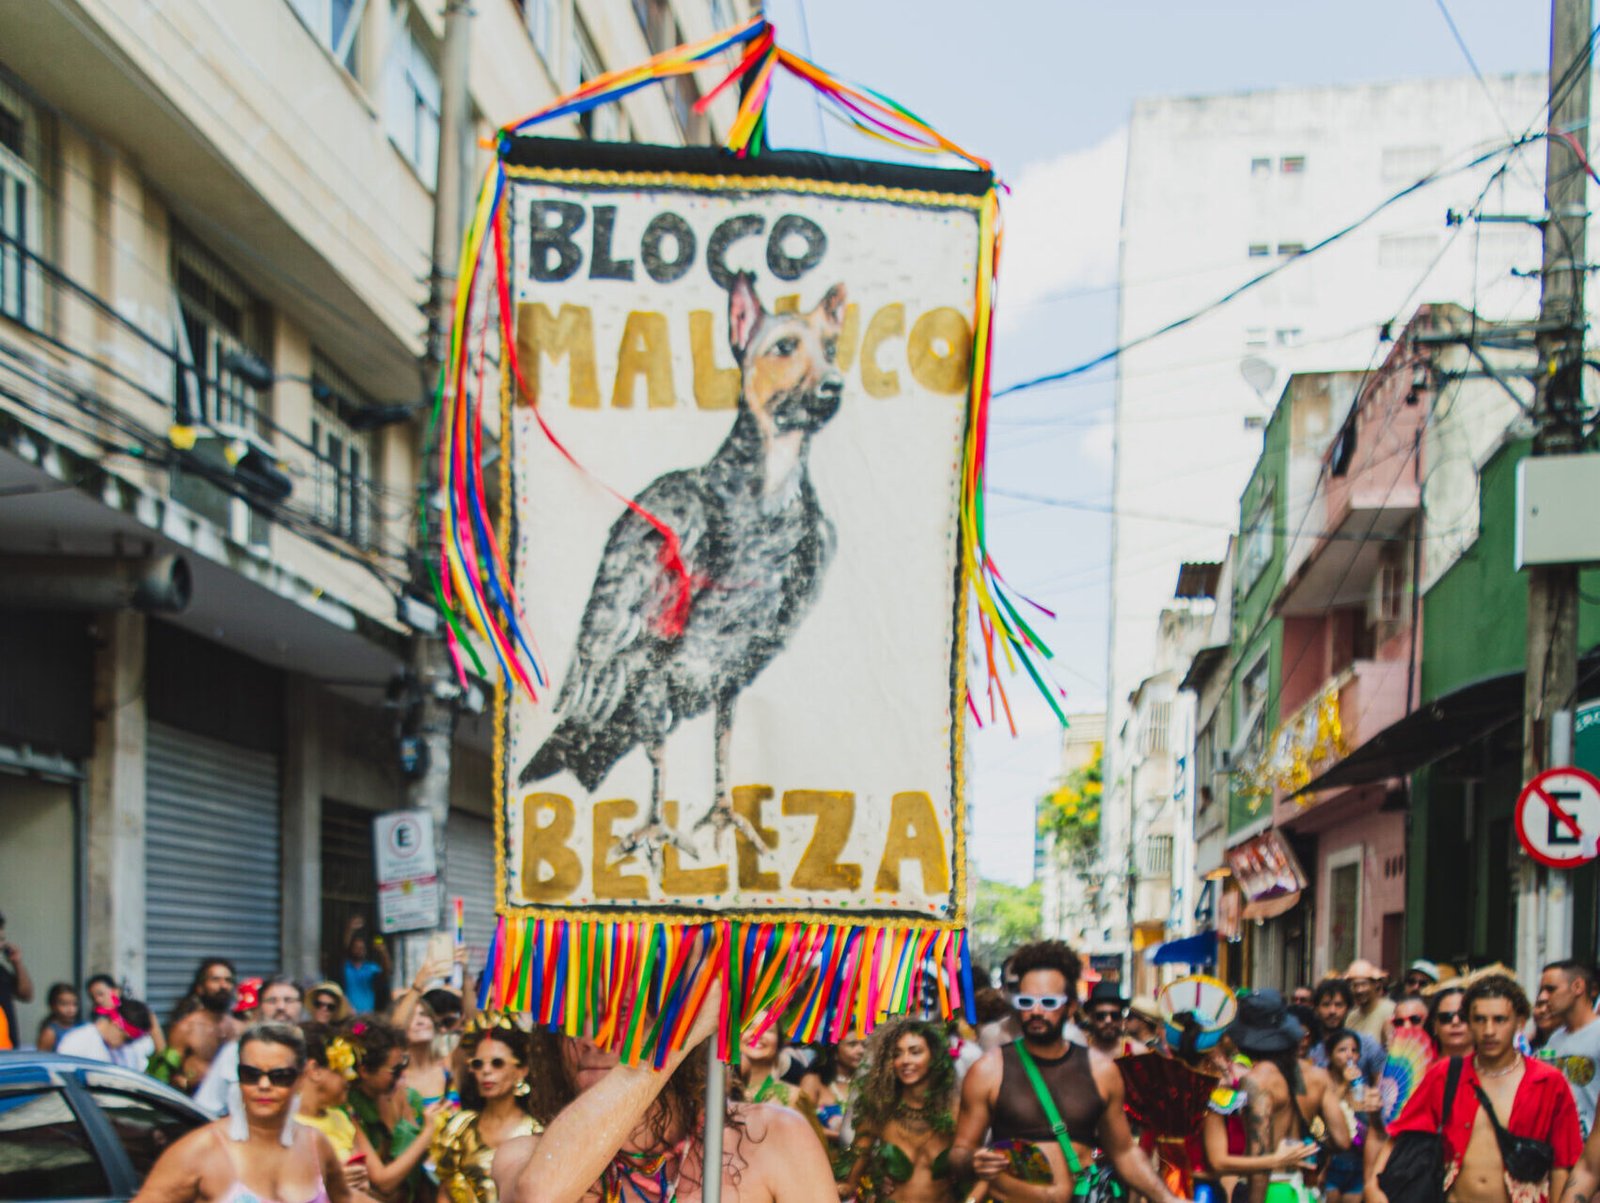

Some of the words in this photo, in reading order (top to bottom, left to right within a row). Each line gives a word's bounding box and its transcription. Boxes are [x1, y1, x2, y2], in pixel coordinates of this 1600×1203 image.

[529, 200, 828, 290] BLOCO
[397, 823, 412, 847] E
[521, 784, 949, 900] BELEZA
[1548, 791, 1581, 845] E
